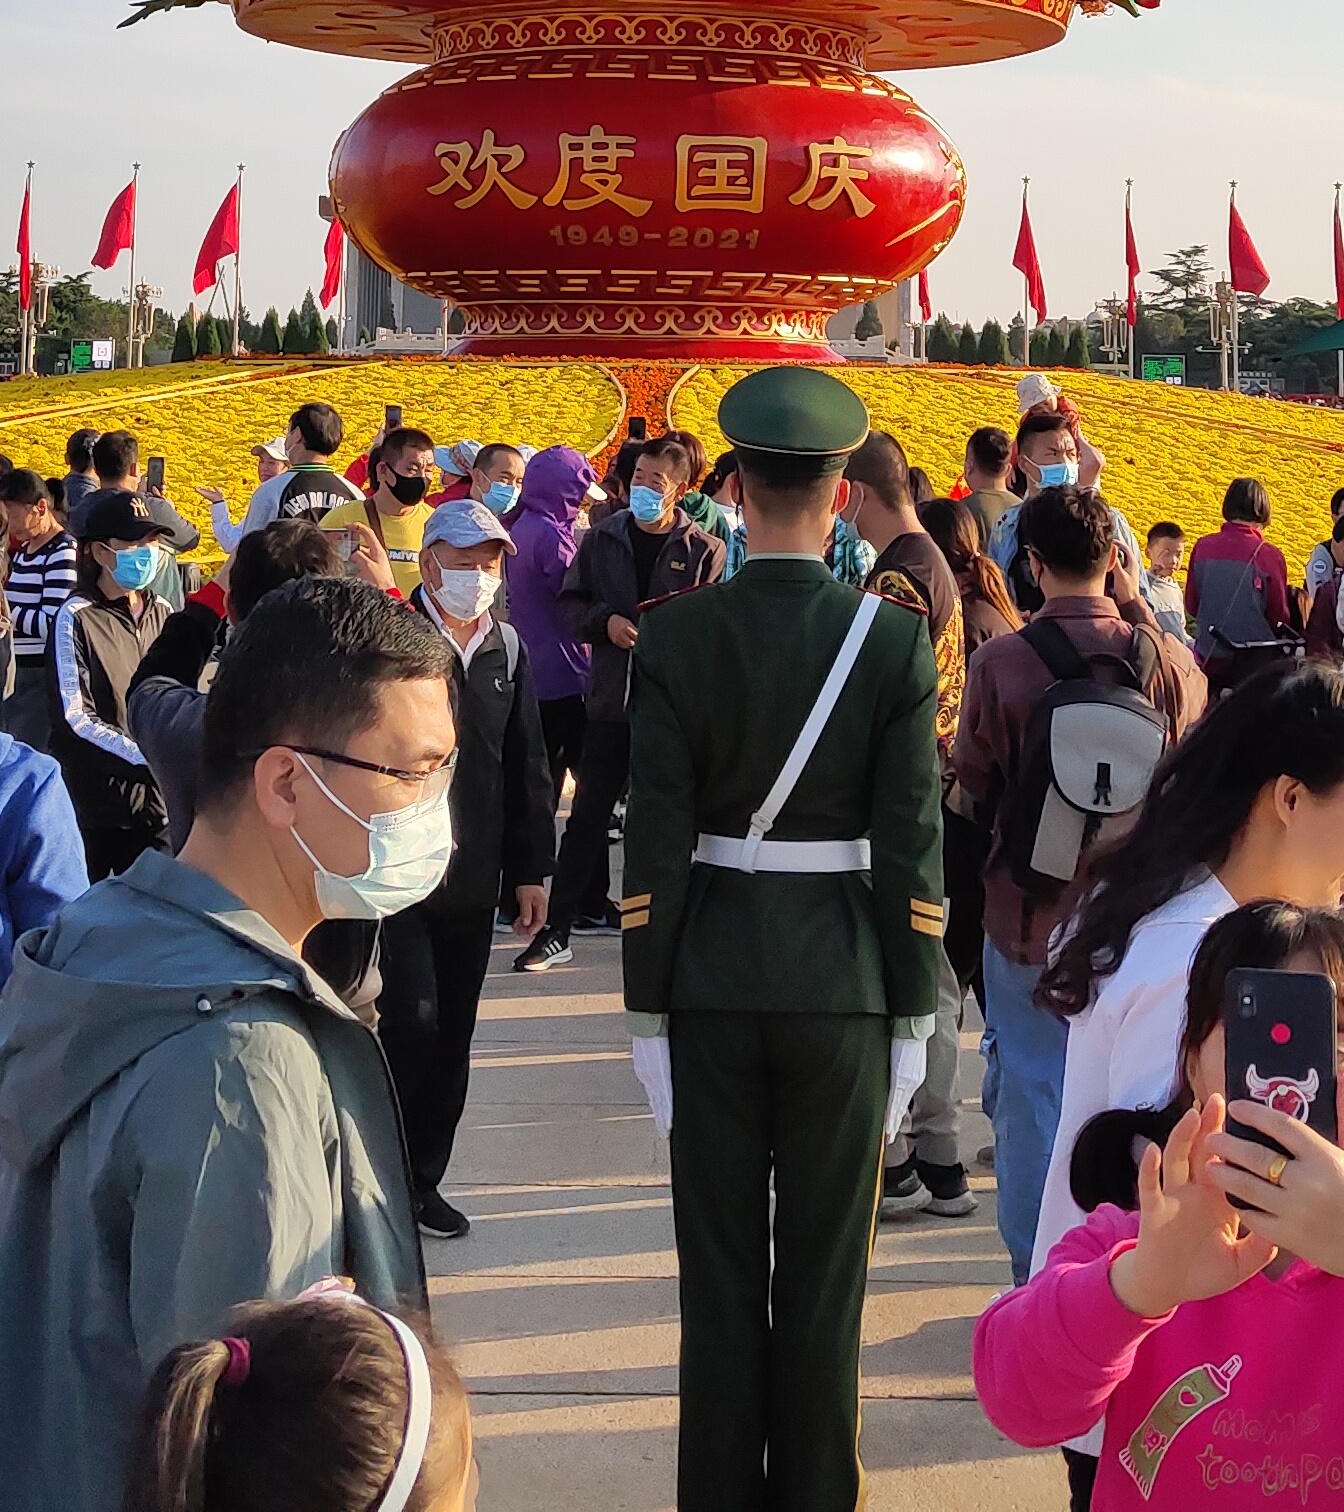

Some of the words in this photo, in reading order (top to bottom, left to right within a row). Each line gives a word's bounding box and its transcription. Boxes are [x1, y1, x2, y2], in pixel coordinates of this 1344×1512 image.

[426, 124, 877, 218] 欢度国庆
[549, 225, 760, 249] 1949-2021
